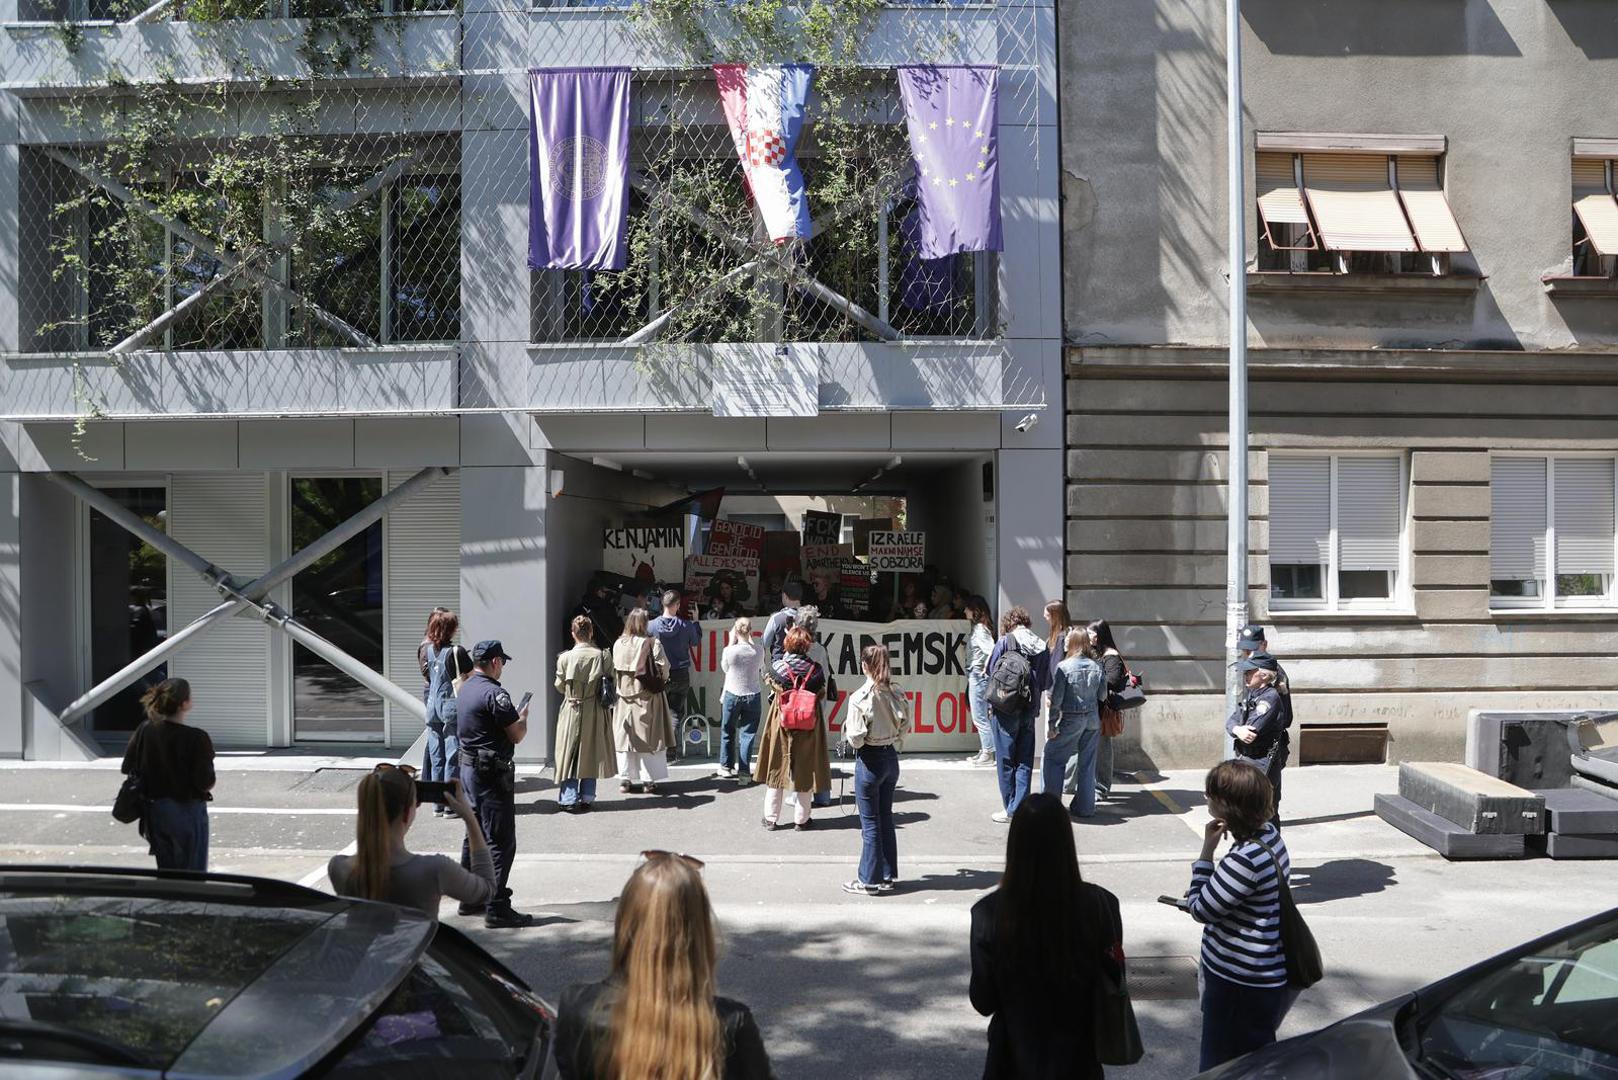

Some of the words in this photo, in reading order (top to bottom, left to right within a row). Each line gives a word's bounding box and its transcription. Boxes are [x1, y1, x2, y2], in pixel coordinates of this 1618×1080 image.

[714, 520, 762, 539] GENOCID
[806, 517, 838, 536] FCK
[603, 528, 684, 553] KENJAMIN
[729, 534, 744, 547] JE
[872, 533, 923, 545] IZRAELE
[710, 543, 759, 559] GENOCID
[805, 546, 839, 559] END
[871, 557, 879, 568] S
[880, 556, 923, 569] OBZORA
